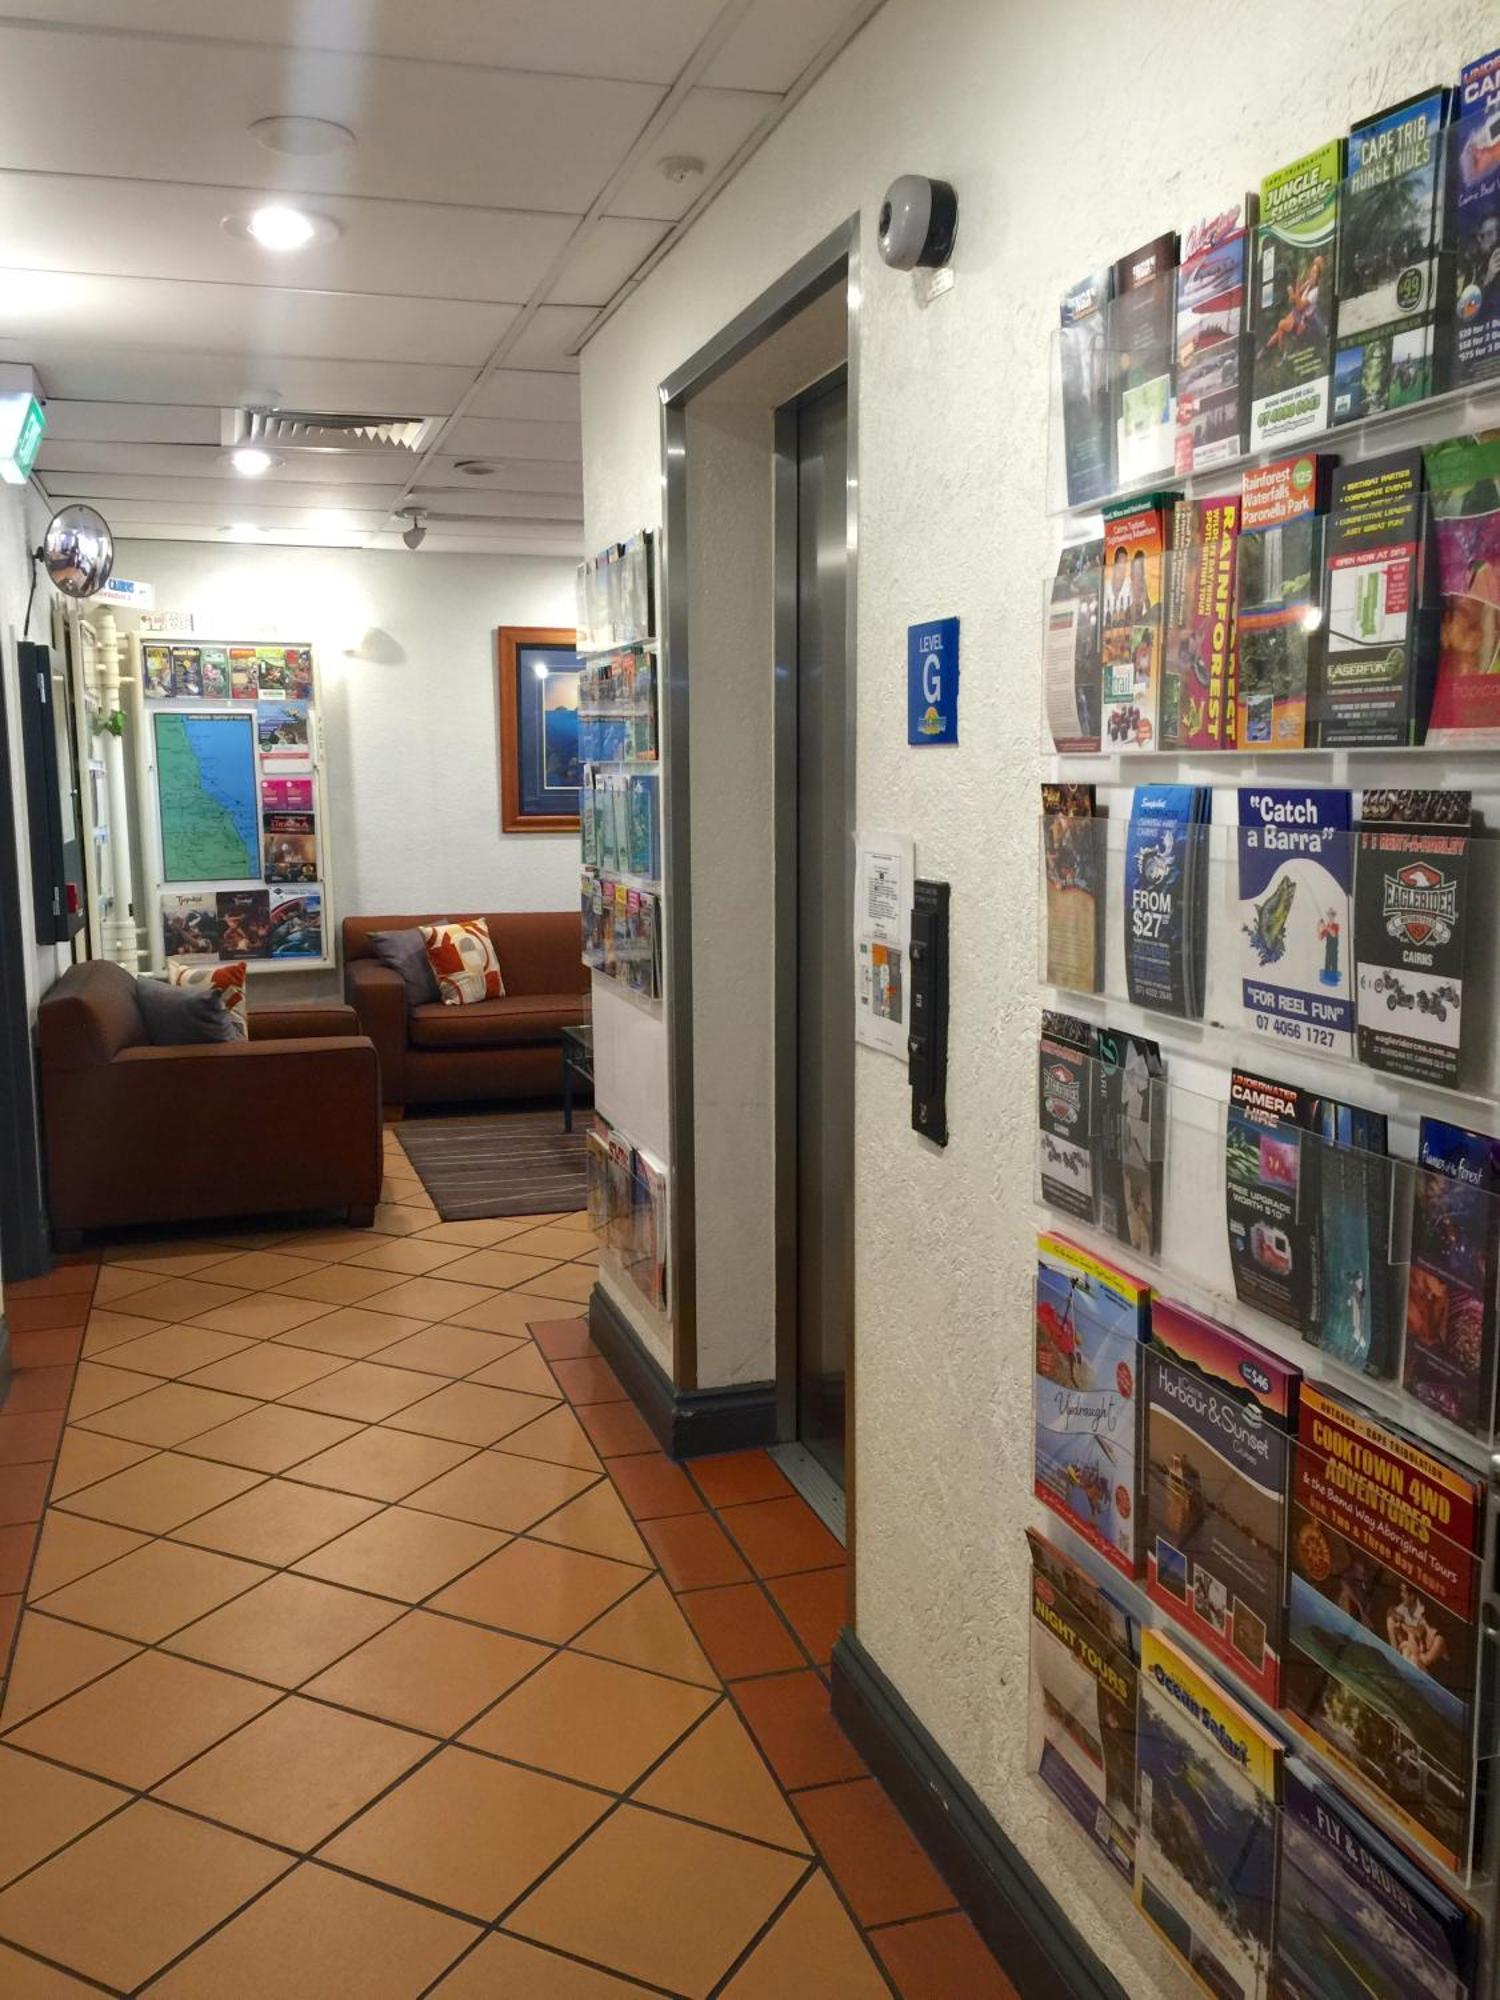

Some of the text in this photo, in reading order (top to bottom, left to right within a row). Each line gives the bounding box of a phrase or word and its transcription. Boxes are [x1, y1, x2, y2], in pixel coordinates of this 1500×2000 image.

[1361, 114, 1427, 166] CAPE TRIB
[1394, 138, 1431, 178] RIDES
[1264, 165, 1322, 212] JUNGLE
[1241, 483, 1290, 509] Waterfalls
[1242, 467, 1291, 492] Rainforest
[1242, 495, 1310, 526] Paronella Park
[1356, 552, 1375, 563] NOW
[1375, 549, 1389, 560] AT
[1208, 505, 1236, 741] RAINFOREST
[919, 633, 944, 653] LEVEL
[922, 653, 941, 704] G
[1249, 795, 1318, 824] "Catch
[1247, 823, 1335, 853] a Barra"
[1132, 888, 1172, 913] FROM
[1386, 883, 1455, 918] EAGLERIDER
[1132, 909, 1162, 938] $27
[1402, 949, 1433, 967] CAIRNS
[1278, 994, 1309, 1016] REEL
[1256, 1014, 1335, 1048] 07 4056 1727
[1231, 1084, 1296, 1118] CAMERA
[1243, 1104, 1280, 1129] HIRE
[1227, 1181, 1292, 1215] FREE UPGRADE
[1232, 1192, 1264, 1212] WORTH
[1159, 1364, 1207, 1417] Harbour
[1208, 1396, 1221, 1428] &
[1221, 1405, 1269, 1460] Sunset
[1366, 1427, 1387, 1447] CAPE
[1312, 1418, 1452, 1526] COOKTOWN 4WD
[1325, 1456, 1432, 1545] ADVENTURES
[1310, 1476, 1326, 1497] the
[1354, 1502, 1377, 1532] Way
[1376, 1518, 1428, 1564] Aboriginal
[1428, 1552, 1459, 1585] Tours
[1034, 1596, 1129, 1699] NIGHT TOURS
[1316, 1805, 1343, 1848] FLY
